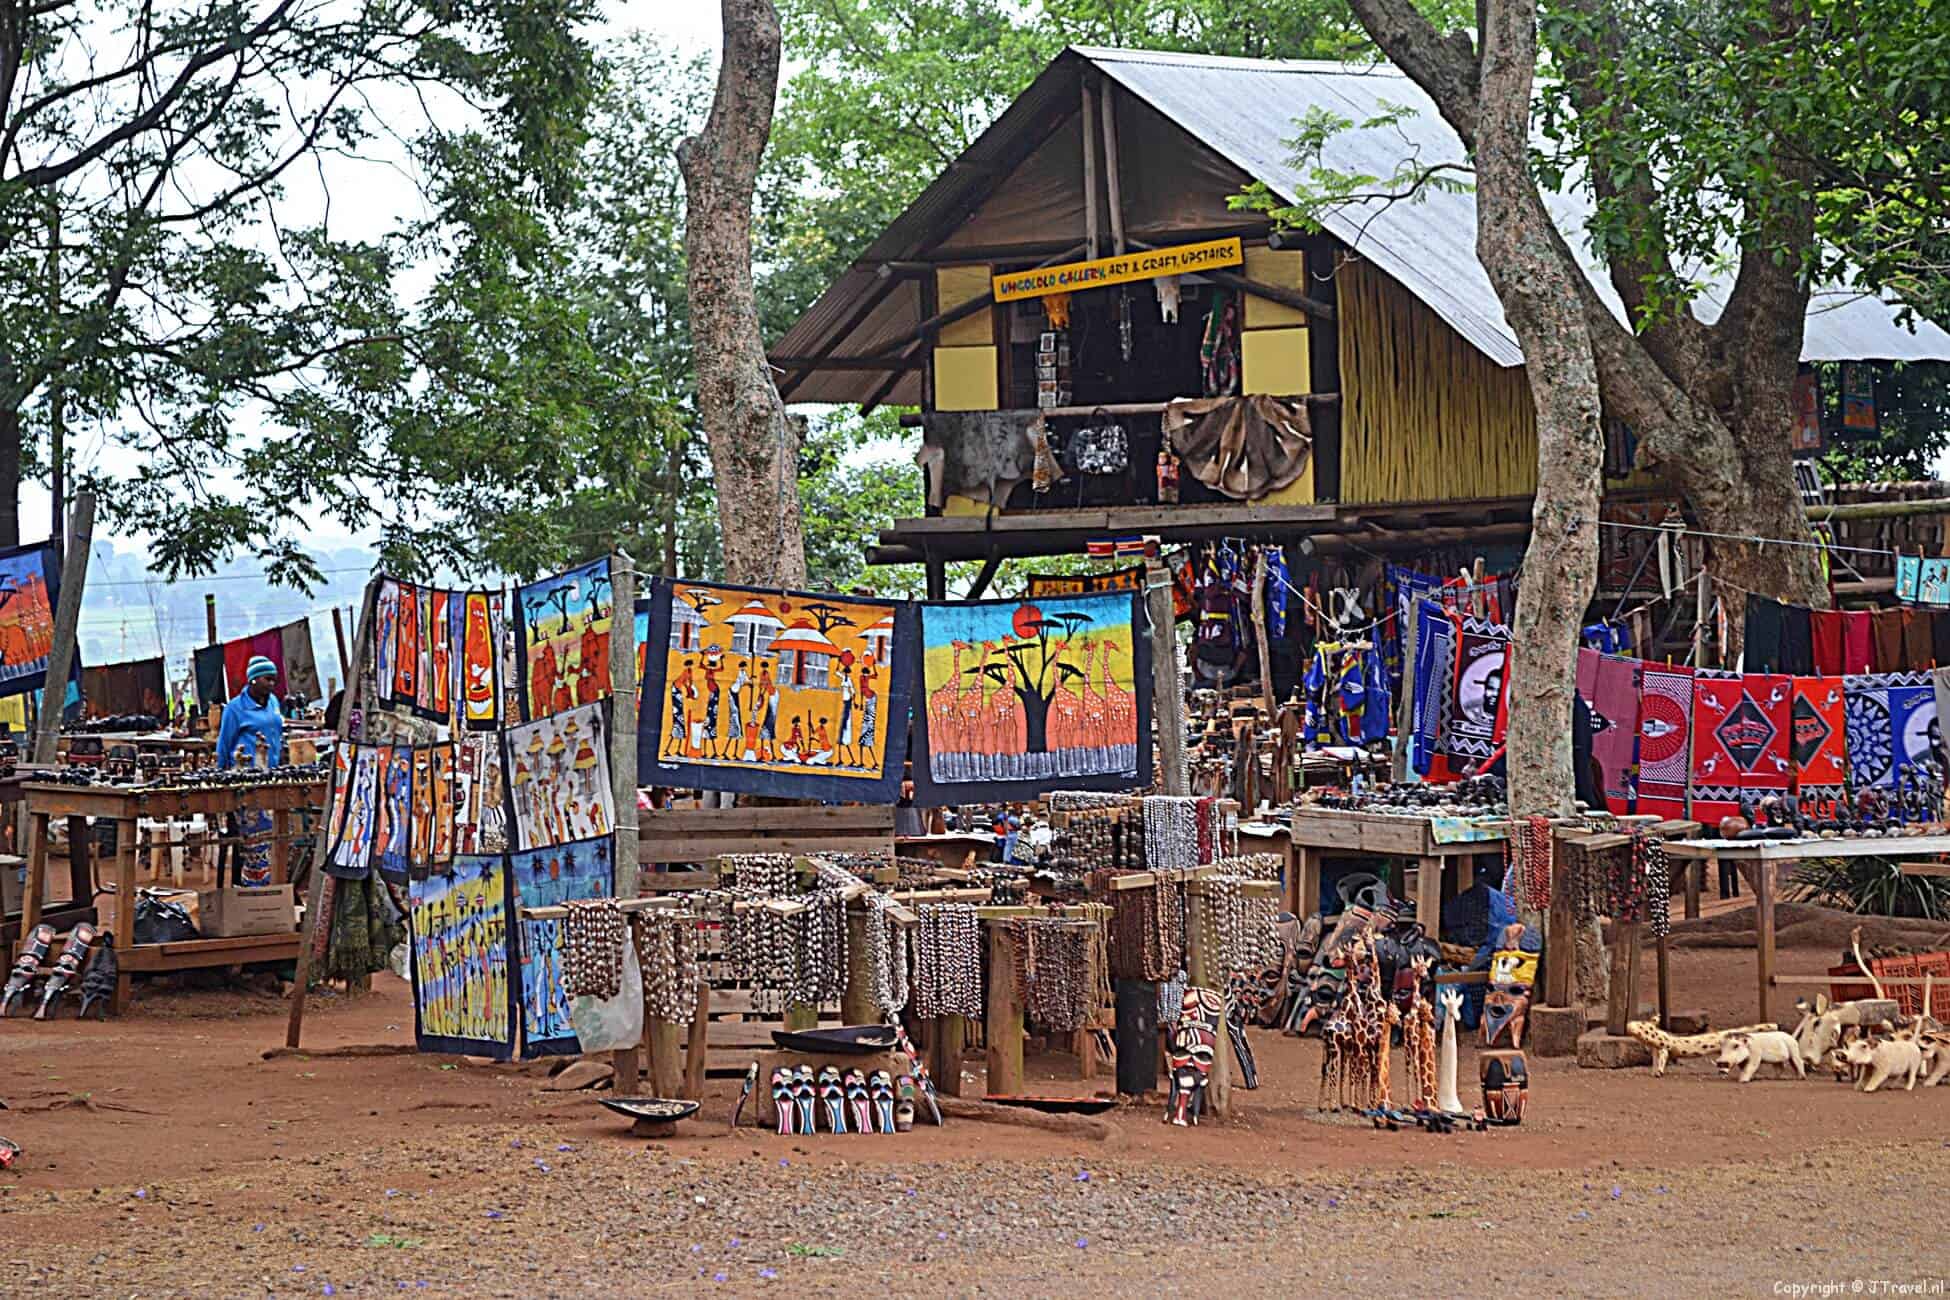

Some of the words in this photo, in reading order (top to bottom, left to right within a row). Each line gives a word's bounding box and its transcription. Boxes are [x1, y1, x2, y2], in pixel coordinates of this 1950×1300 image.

[1108, 262, 1129, 275] ART
[1132, 261, 1139, 273] &
[1181, 246, 1234, 265] UPSTAIRS
